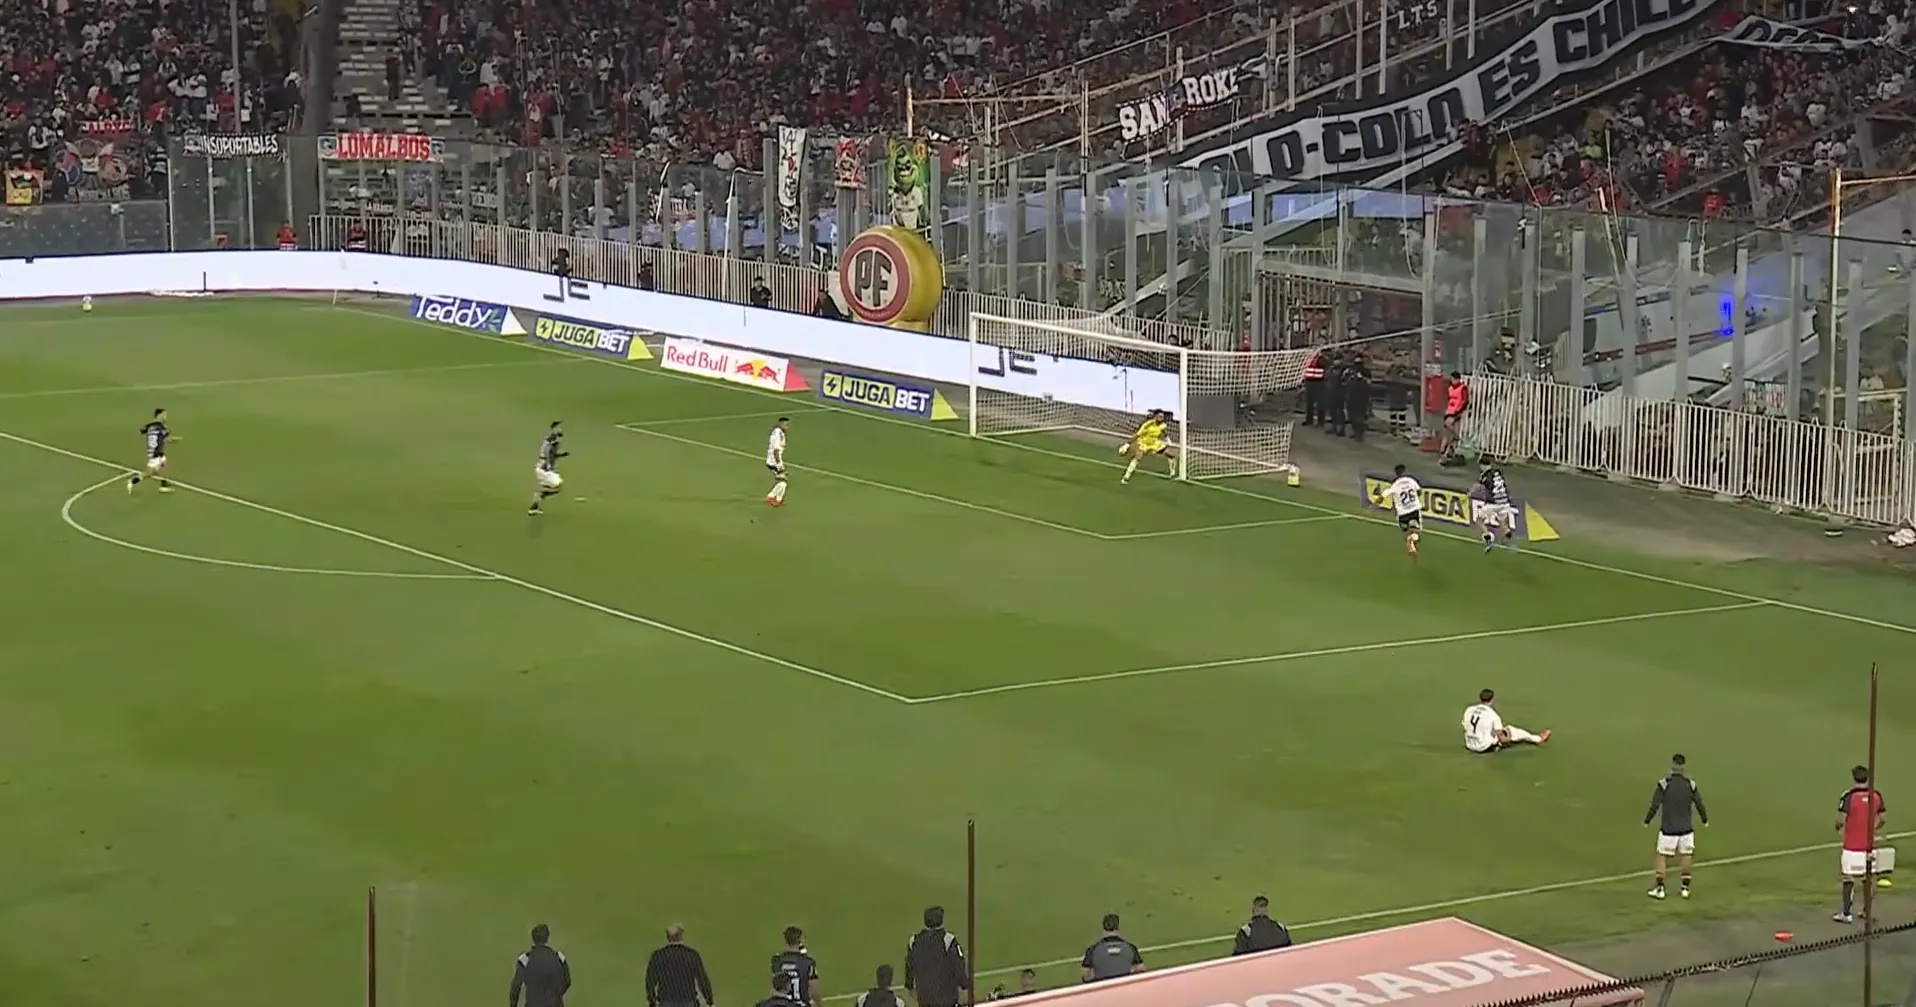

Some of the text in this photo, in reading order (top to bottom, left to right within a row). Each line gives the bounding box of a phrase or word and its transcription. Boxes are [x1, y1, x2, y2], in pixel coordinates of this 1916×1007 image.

[1479, 39, 1542, 113] ES
[1119, 67, 1239, 140] SAN ROKE
[200, 133, 279, 155] INSOPORTABLES
[337, 134, 430, 160] LOMALBOS
[854, 249, 893, 308] PF
[416, 294, 491, 329] Teddy
[667, 345, 729, 373] Red Bull
[1470, 714, 1480, 734] 4
